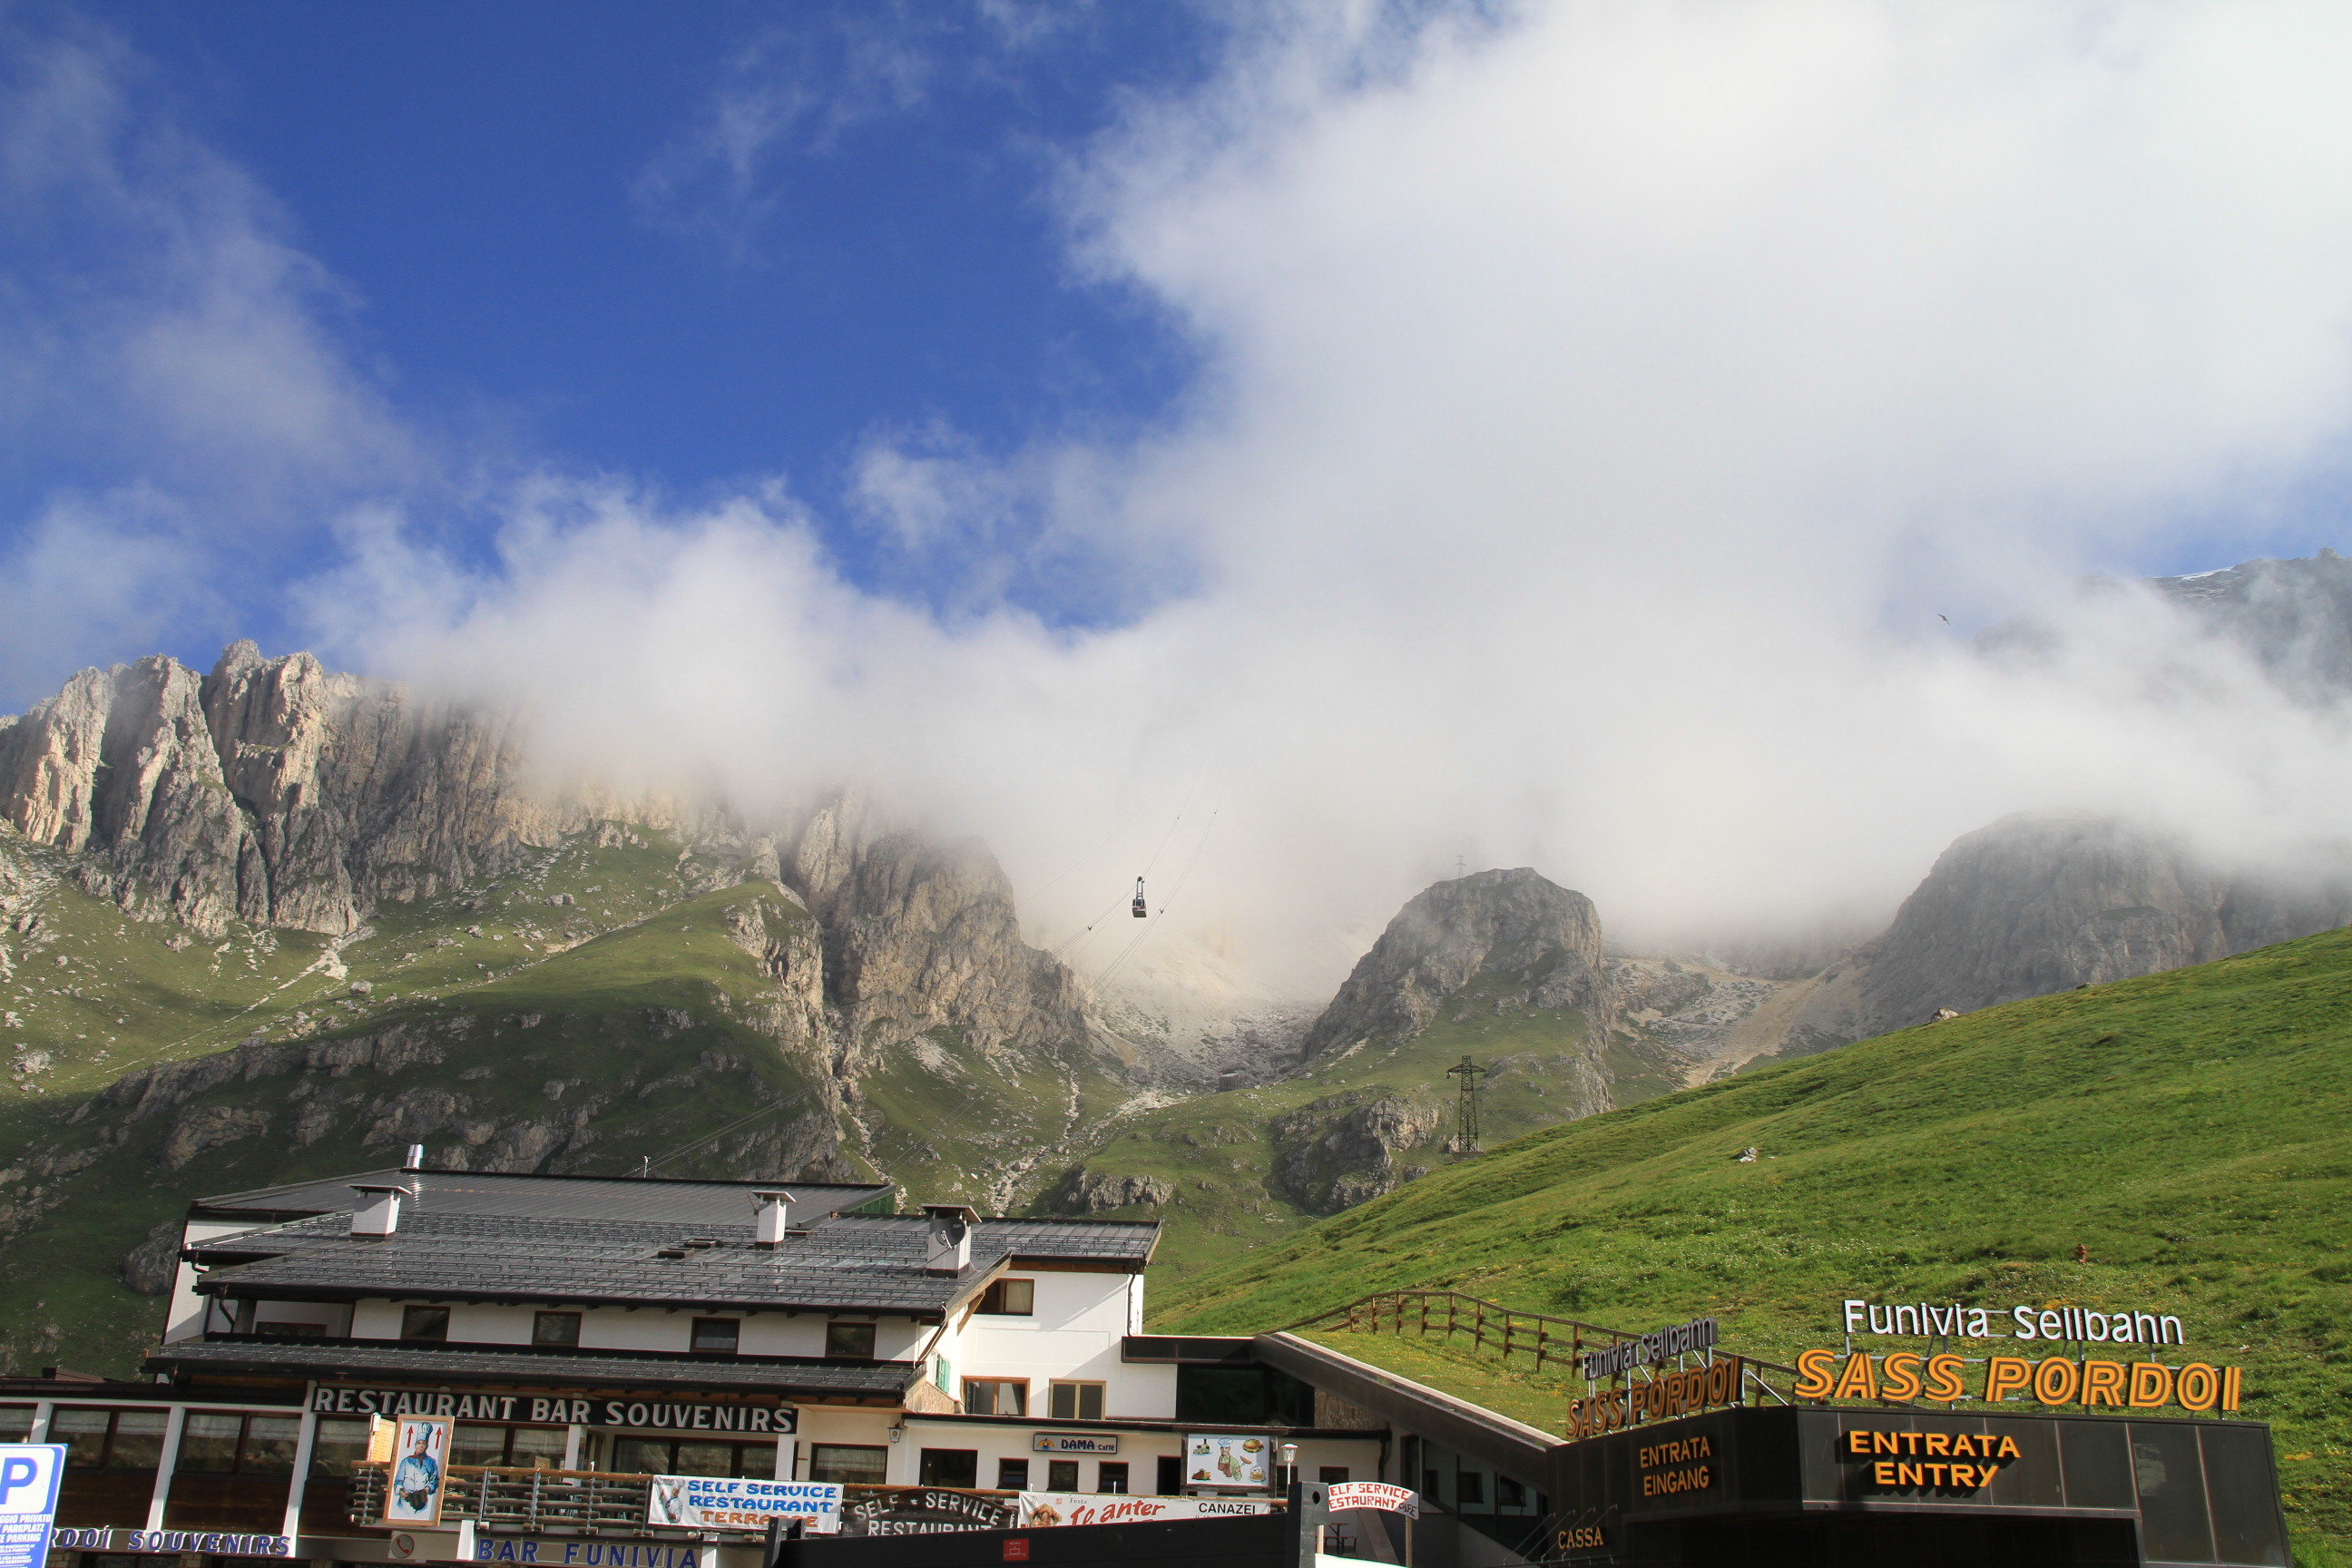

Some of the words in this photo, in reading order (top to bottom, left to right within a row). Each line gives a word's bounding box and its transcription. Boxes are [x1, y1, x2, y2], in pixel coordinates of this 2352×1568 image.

[1843, 1299, 1990, 1338] Funivia
[2013, 1305, 2183, 1345] Seilbahn
[1583, 1342, 1632, 1381] Funivia
[1641, 1317, 1714, 1364] Seilbahn
[1794, 1348, 1965, 1403] SASS
[1984, 1356, 2241, 1412] PORDOI
[315, 1387, 517, 1420] RESTAURANT
[531, 1397, 590, 1424] BAR
[605, 1401, 793, 1433] SOUVENIRS
[1566, 1387, 1625, 1439] SASS
[1630, 1356, 1740, 1426] PORDOI
[1061, 1439, 1095, 1450] DAMA
[1640, 1436, 1711, 1468] ENTRATA
[1849, 1430, 2022, 1458] ENTRATA
[0, 1456, 38, 1504] P
[1643, 1465, 1710, 1496] EINGANG
[1874, 1461, 1999, 1487] ENTRY
[687, 1480, 740, 1494] SELF
[746, 1483, 838, 1498] SERVICE
[1328, 1484, 1353, 1496] ELF
[1358, 1483, 1409, 1500] SERVICE
[689, 1495, 834, 1513] RESTAURANT
[854, 1494, 899, 1521] SELF
[926, 1492, 1003, 1525] SERVICE
[1100, 1500, 1166, 1524] anter
[1199, 1503, 1256, 1515] CANAZEI
[1328, 1495, 1396, 1509] ESTAURANT
[1398, 1503, 1416, 1516] CAFE
[2, 1524, 45, 1533] PARKPLATZ
[19, 1514, 52, 1523] PRIVATO
[701, 1510, 819, 1527] TERRAE
[867, 1520, 992, 1536] RESTAURA
[5, 1534, 42, 1543] PARKING
[127, 1530, 291, 1556] SOUVENIRS
[1558, 1526, 1604, 1550] CASSA
[477, 1539, 538, 1562] BAR
[564, 1543, 698, 1568] FUNIVIA
